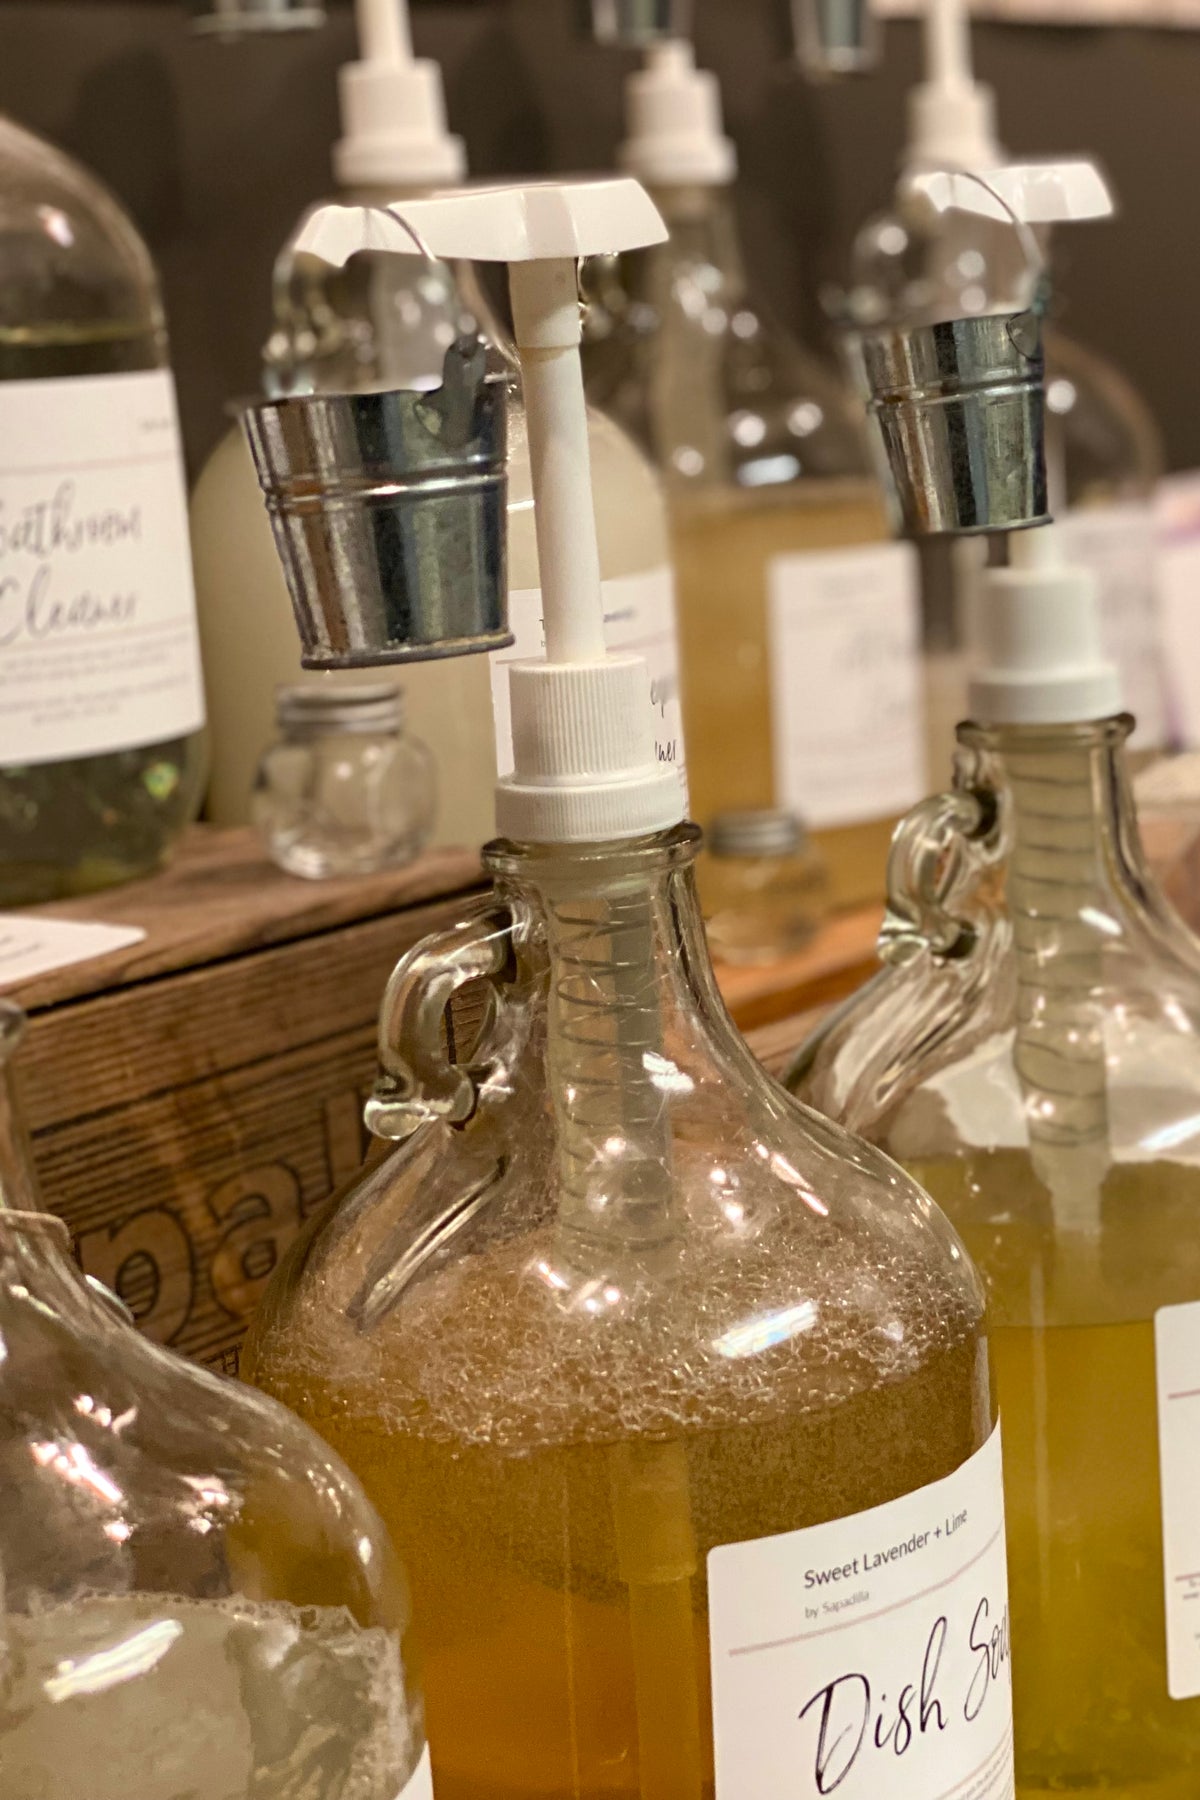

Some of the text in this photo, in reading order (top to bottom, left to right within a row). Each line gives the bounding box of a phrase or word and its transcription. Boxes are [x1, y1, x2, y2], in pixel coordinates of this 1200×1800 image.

[0, 478, 142, 560] athroom
[804, 1508, 968, 1589] Sweet Lavender + Lime
[805, 1590, 870, 1619] by Sapadilla
[798, 1616, 947, 1795] Dish
